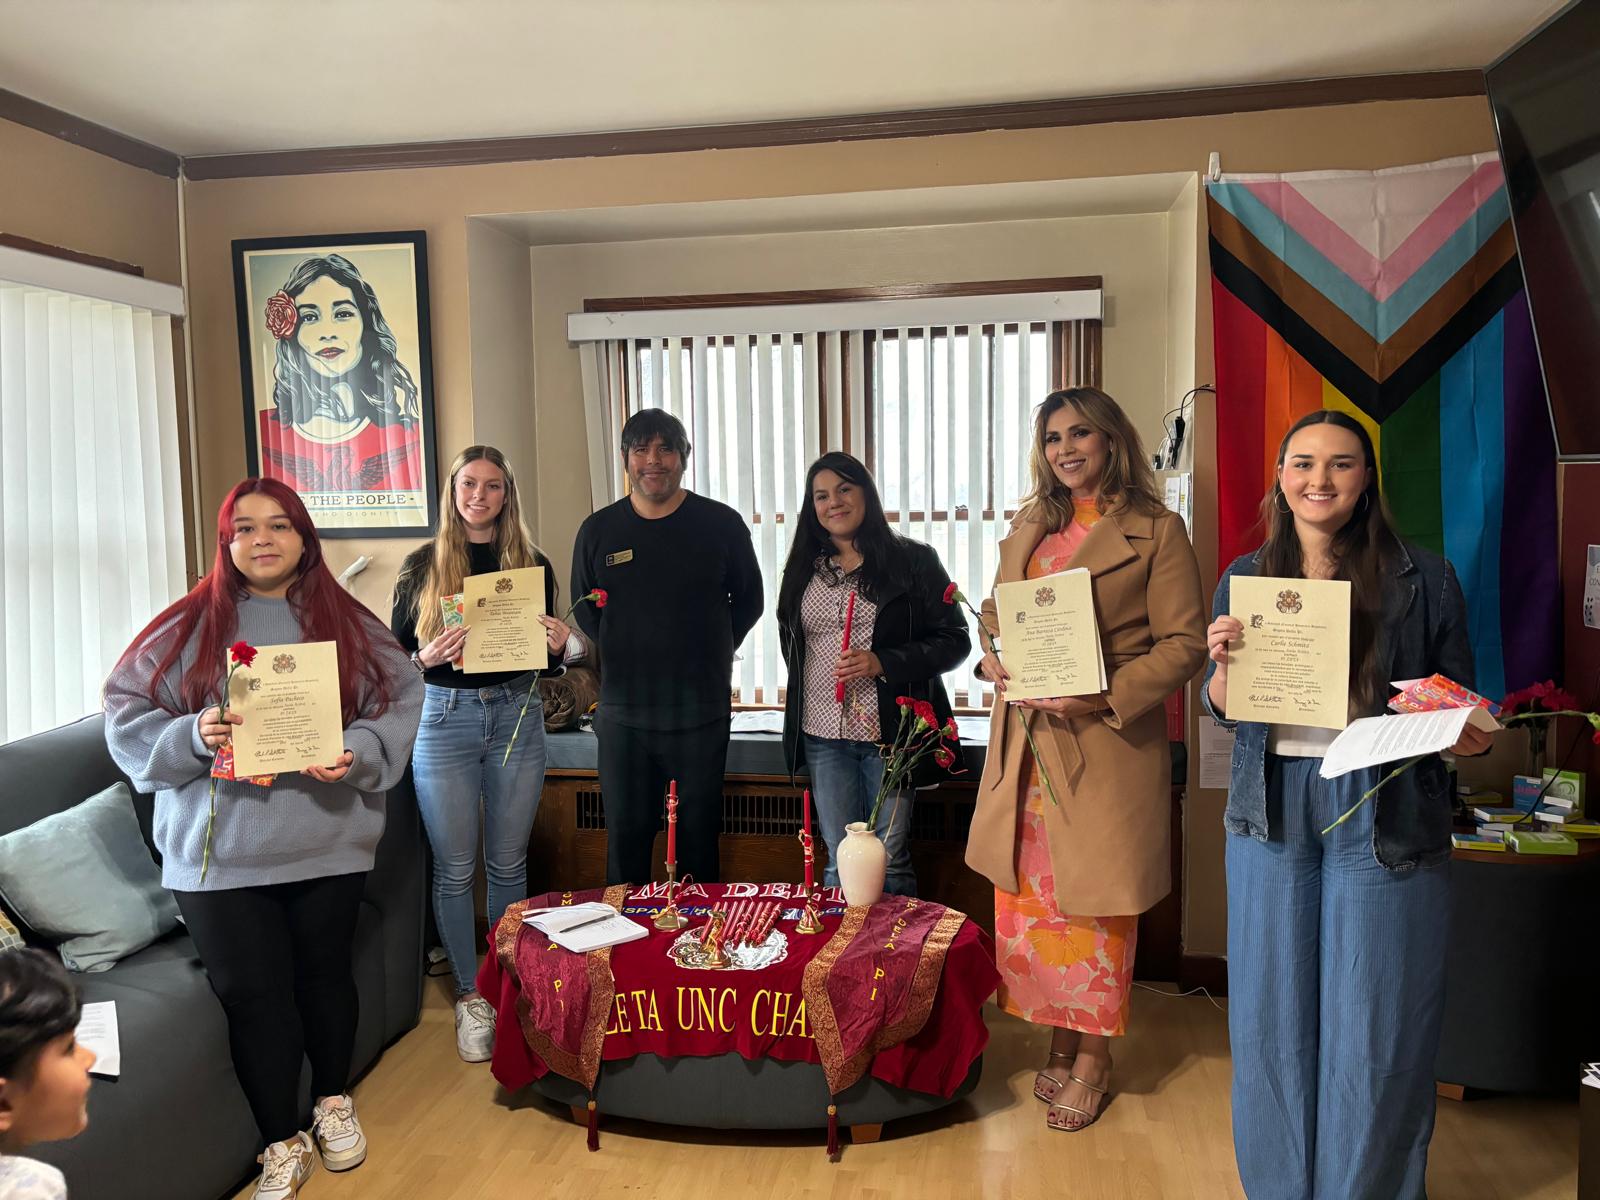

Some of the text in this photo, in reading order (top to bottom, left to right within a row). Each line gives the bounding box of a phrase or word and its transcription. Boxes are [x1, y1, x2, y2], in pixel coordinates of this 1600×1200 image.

[310, 494, 341, 505] THE
[346, 494, 407, 505] PEOPLE
[625, 882, 710, 900] MA
[870, 968, 885, 1001] PI
[676, 986, 737, 1033] UNC
[750, 988, 817, 1039] CHA
